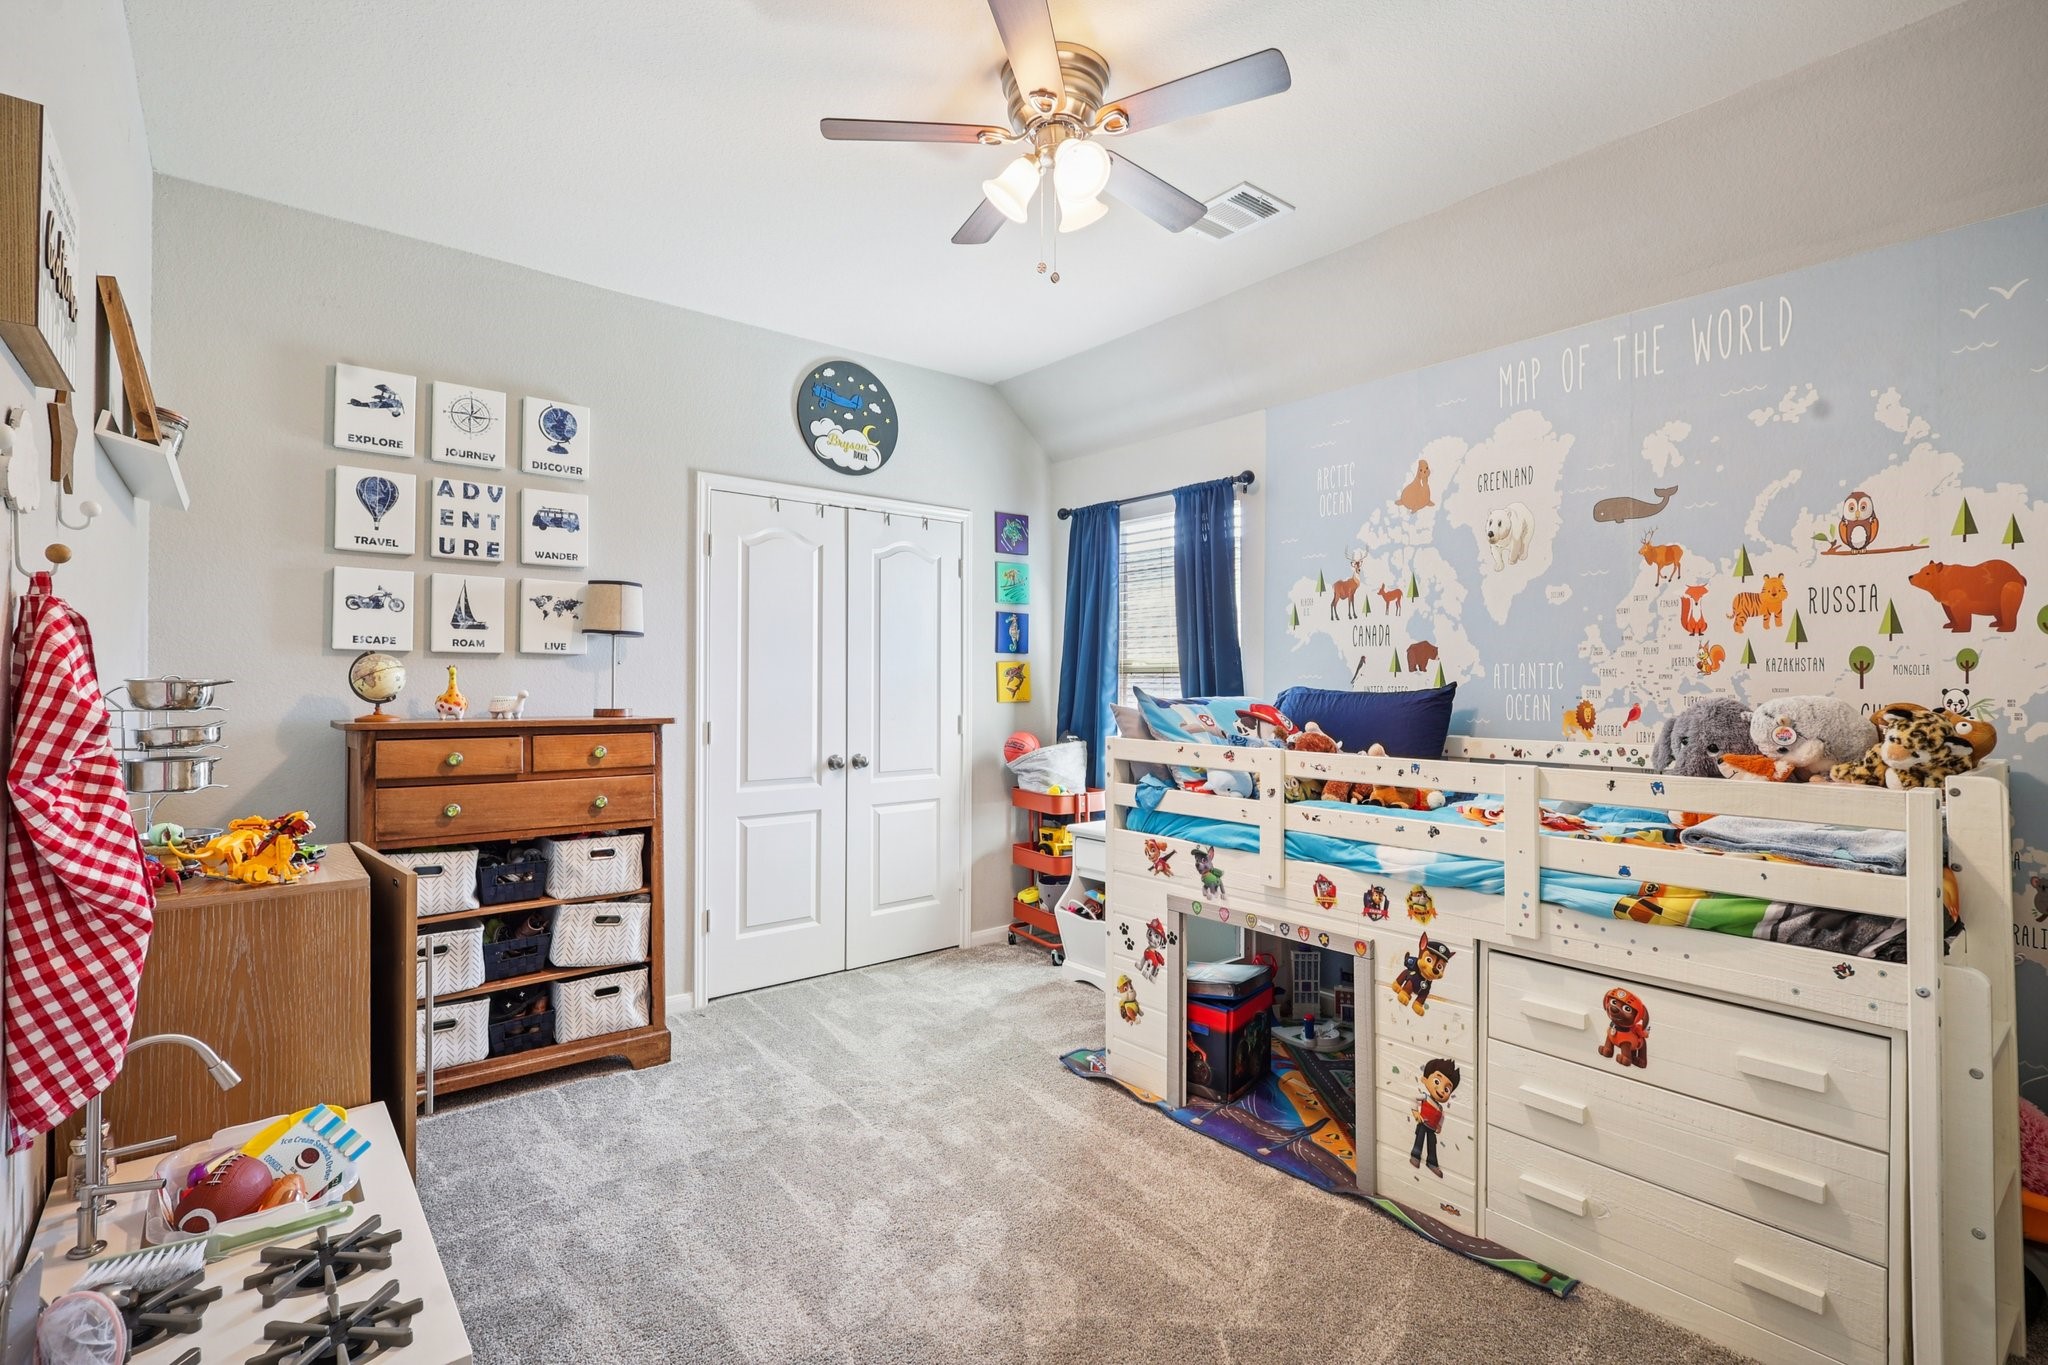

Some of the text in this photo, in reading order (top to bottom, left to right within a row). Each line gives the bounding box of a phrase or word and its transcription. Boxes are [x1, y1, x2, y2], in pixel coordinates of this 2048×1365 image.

[1499, 296, 1793, 409] MAP OF THE WORLD
[347, 433, 404, 449] EXPLORE
[445, 447, 497, 462] JOURNEY
[531, 460, 583, 475] DISCOVER
[1317, 462, 1355, 491] ARCTIC
[1477, 465, 1535, 493] GREENLAND
[437, 479, 504, 504] ADV
[1320, 491, 1352, 517] OCEAN
[440, 509, 501, 531] ENT
[354, 535, 399, 548] TRAVEL
[438, 536, 500, 558] URE
[535, 551, 579, 562] WANDER
[1807, 583, 1879, 616] RUSSIA
[352, 635, 397, 645] ESCAPE
[452, 638, 486, 648] ROAM
[1352, 624, 1391, 648] CANADA
[544, 642, 567, 651] LIVE
[1671, 656, 1695, 668] UKRAINE
[1765, 657, 1826, 673] KAZAKHSTAN
[1493, 662, 1565, 690] ATLANTIC
[1599, 668, 1618, 678] FRANCE
[1893, 664, 1930, 676] MONGOLIA
[1585, 690, 1602, 699] SPAIN
[1505, 695, 1552, 722] OCEAN
[1596, 725, 1623, 737] ALGERIA
[1636, 732, 1656, 744] LIBYA
[280, 1137, 293, 1145] Ice
[293, 1135, 315, 1145] Cream
